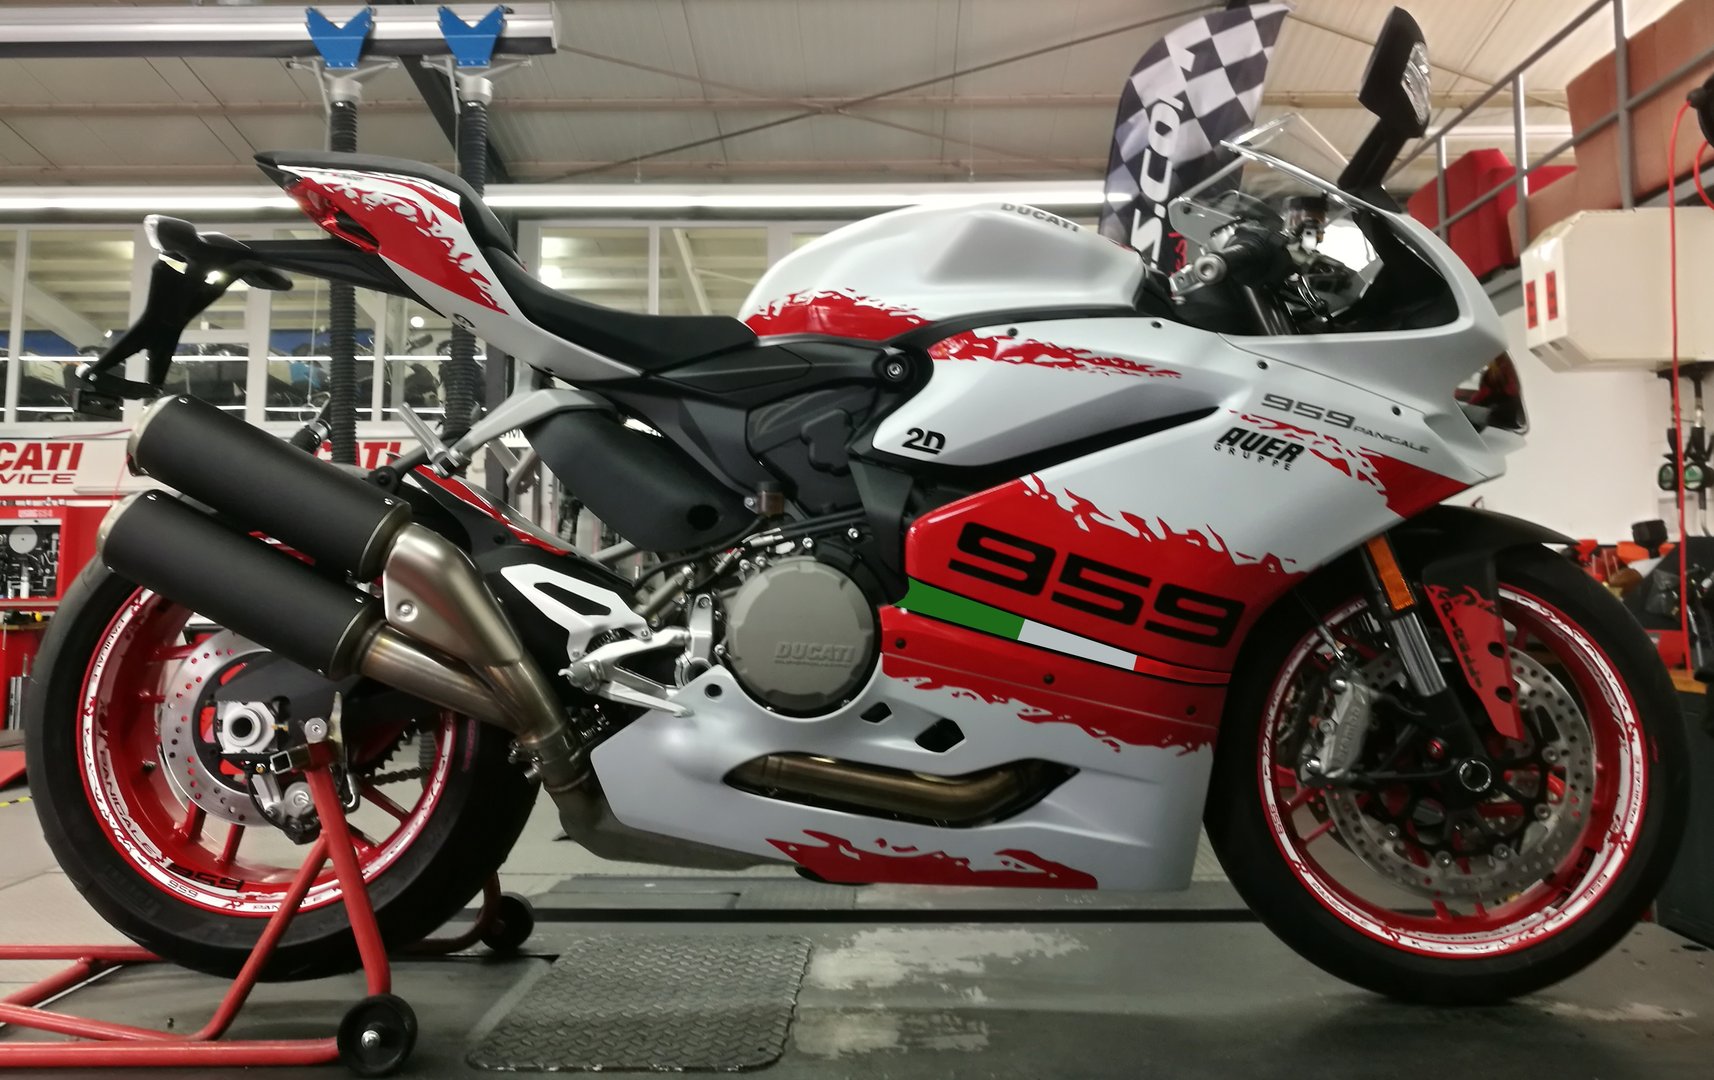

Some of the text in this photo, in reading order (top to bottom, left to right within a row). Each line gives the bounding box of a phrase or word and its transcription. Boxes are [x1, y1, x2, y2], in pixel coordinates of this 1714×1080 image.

[1000, 203, 1080, 233] DUCATI
[1261, 393, 1431, 454] 959 PANIGALE
[1214, 443, 1292, 472] GRUPPE
[1216, 427, 1306, 464] AUER
[948, 521, 1246, 648] 959
[774, 640, 857, 665] DUCATI
[99, 749, 159, 856] PANIGALE
[1268, 802, 1285, 836] 959
[167, 879, 200, 899] 959
[1311, 880, 1371, 928] PANIGALE
